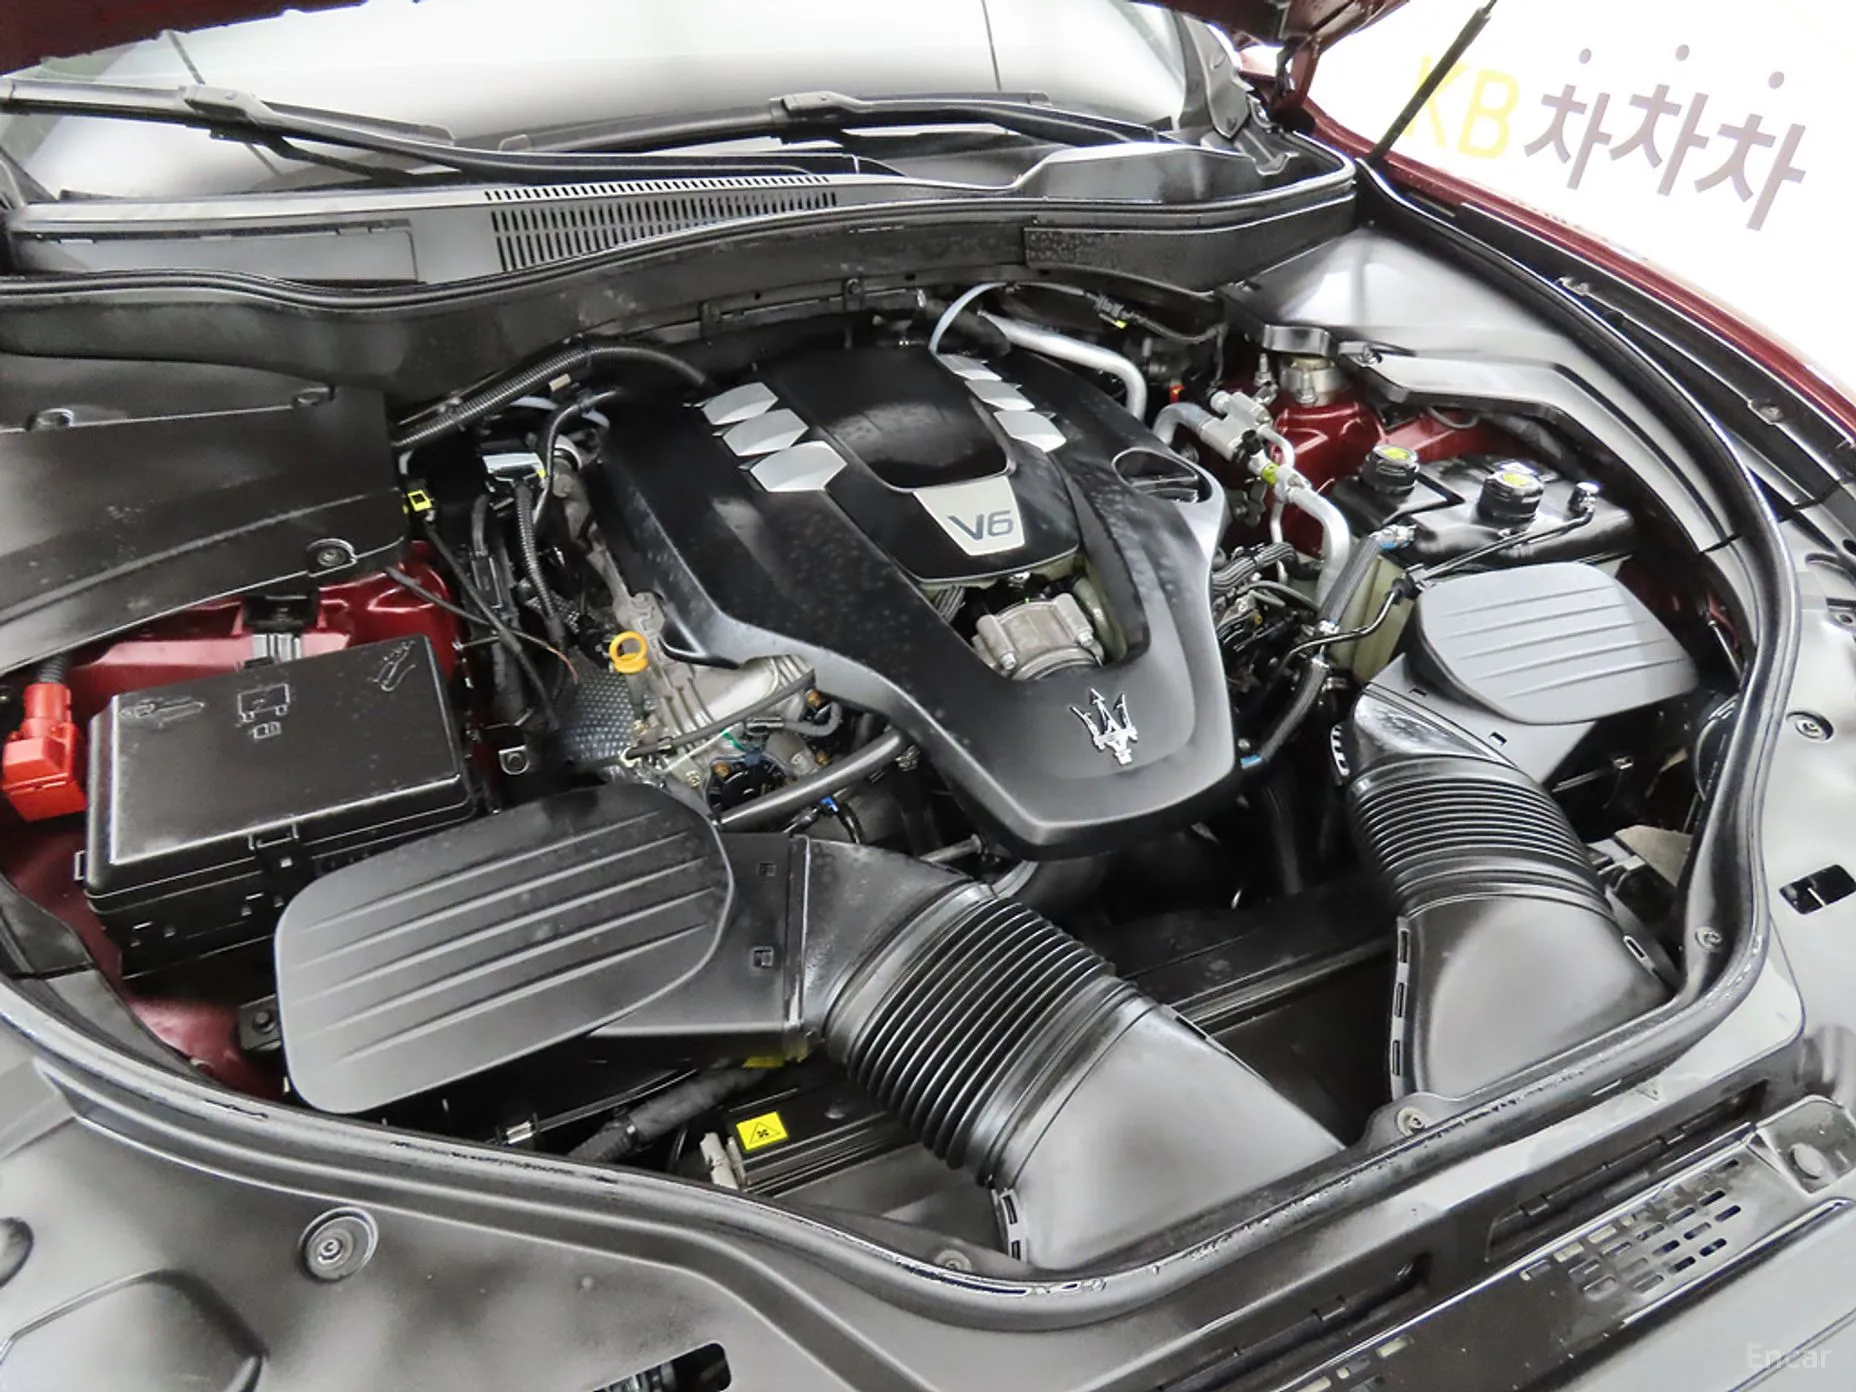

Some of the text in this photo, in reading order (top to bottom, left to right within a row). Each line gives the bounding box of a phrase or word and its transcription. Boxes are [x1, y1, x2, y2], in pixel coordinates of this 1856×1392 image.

[1403, 44, 1806, 231] KB 차차차
[948, 510, 1014, 541] V6
